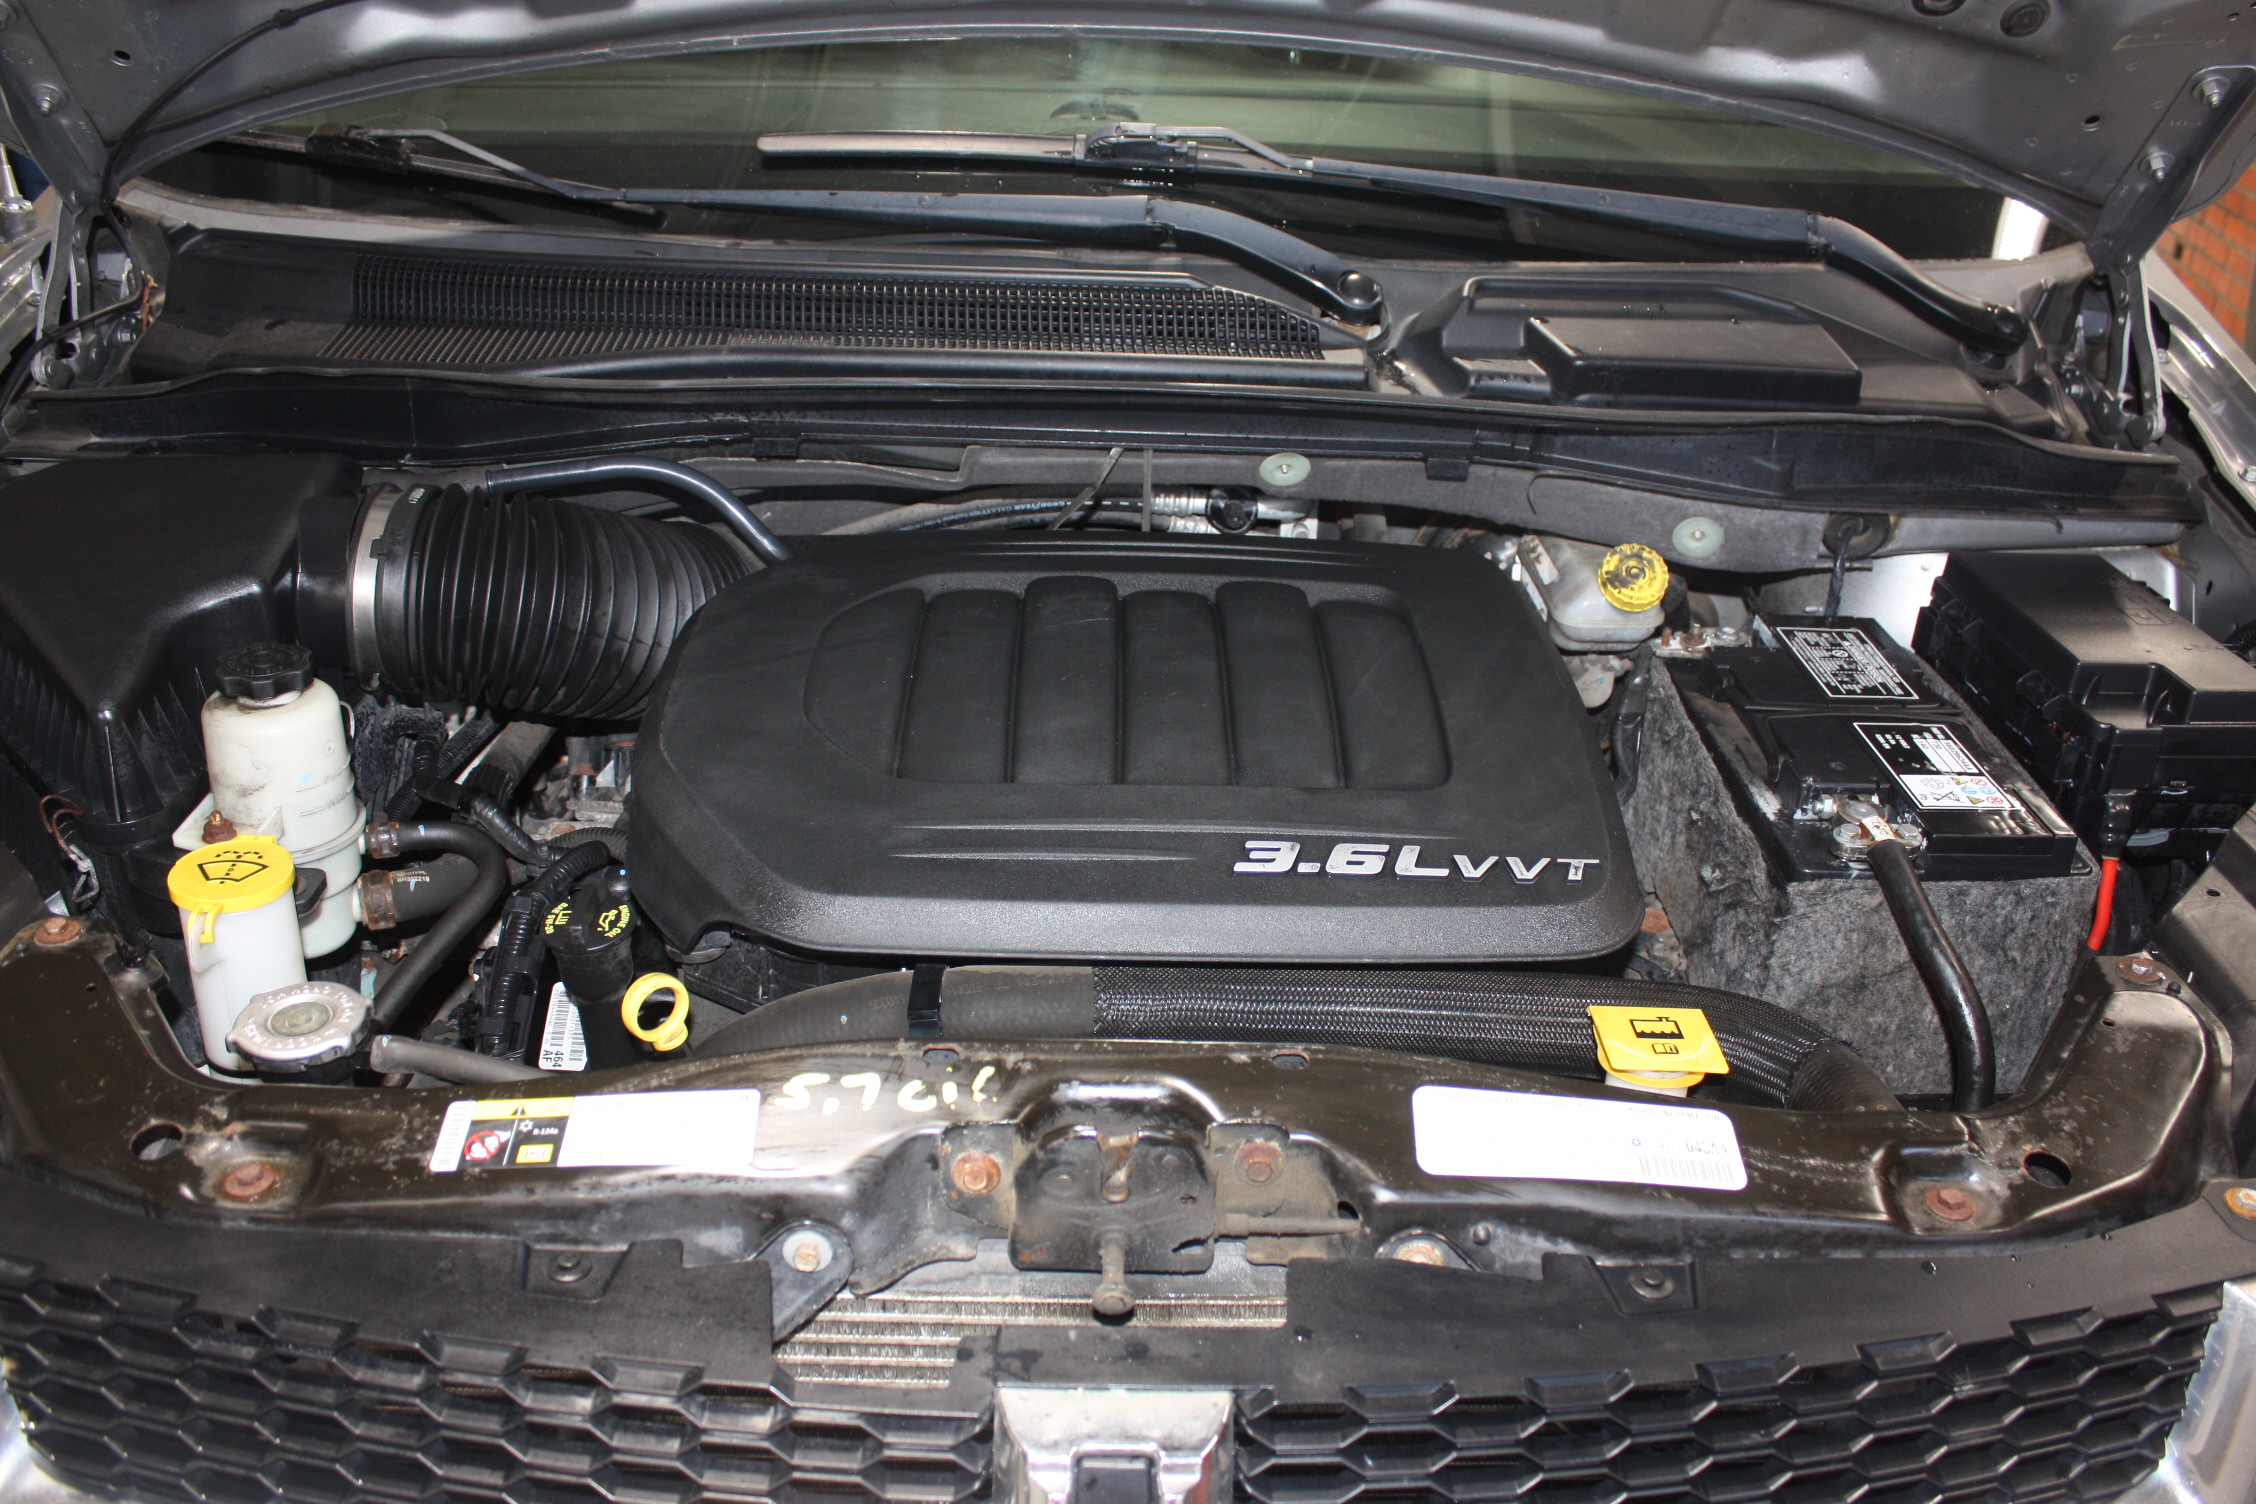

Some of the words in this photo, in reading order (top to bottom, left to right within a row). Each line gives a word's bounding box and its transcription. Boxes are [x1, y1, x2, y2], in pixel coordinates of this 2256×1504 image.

[1452, 854, 1600, 885] VVT
[616, 904, 631, 929] ENGINE
[604, 927, 622, 938] OIL
[542, 1049, 554, 1063] AF
[551, 1049, 564, 1068] 464
